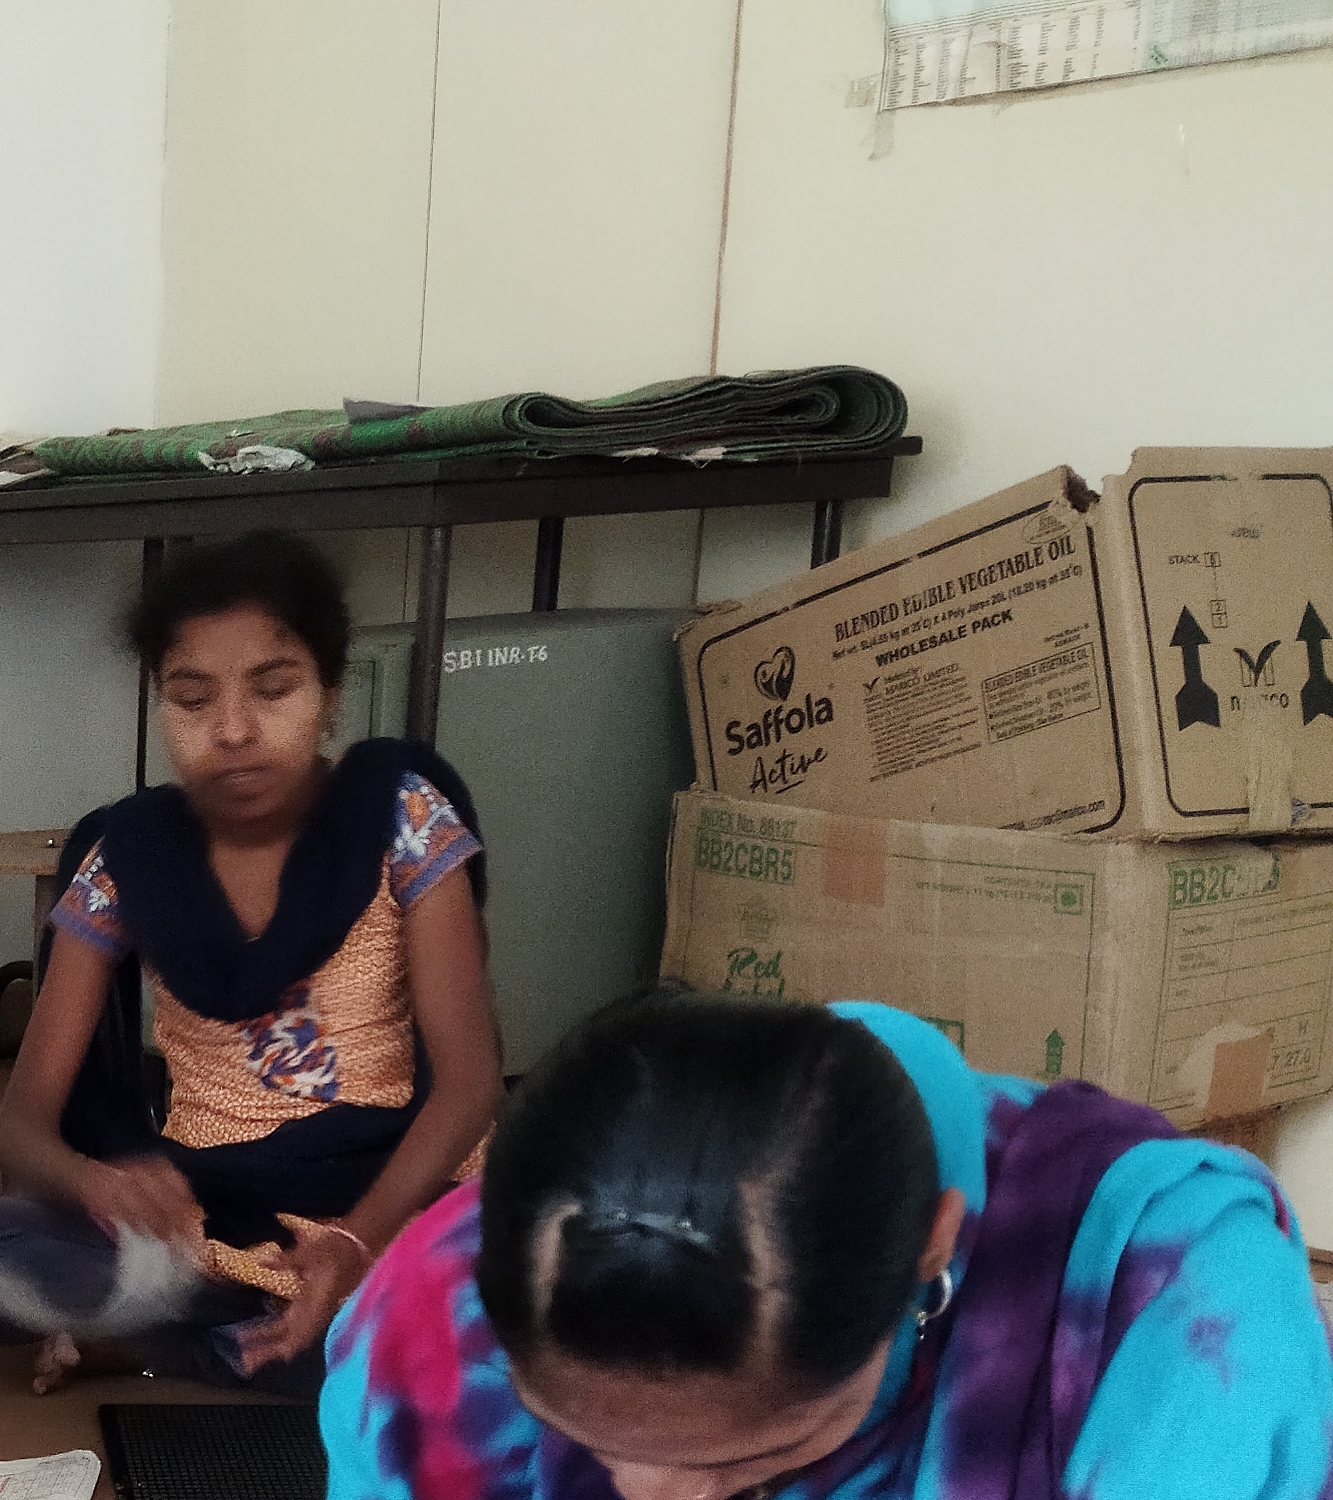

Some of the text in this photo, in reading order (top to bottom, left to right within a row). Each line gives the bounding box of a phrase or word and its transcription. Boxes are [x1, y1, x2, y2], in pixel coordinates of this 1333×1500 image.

[835, 611, 900, 642] BLENDED
[956, 547, 1046, 597] VEGETABLE
[1045, 534, 1078, 560] OIL
[873, 608, 1015, 667] WHOLESALE PACK
[725, 694, 833, 756] Saffola
[750, 747, 827, 794] Active
[727, 948, 782, 978] Red
